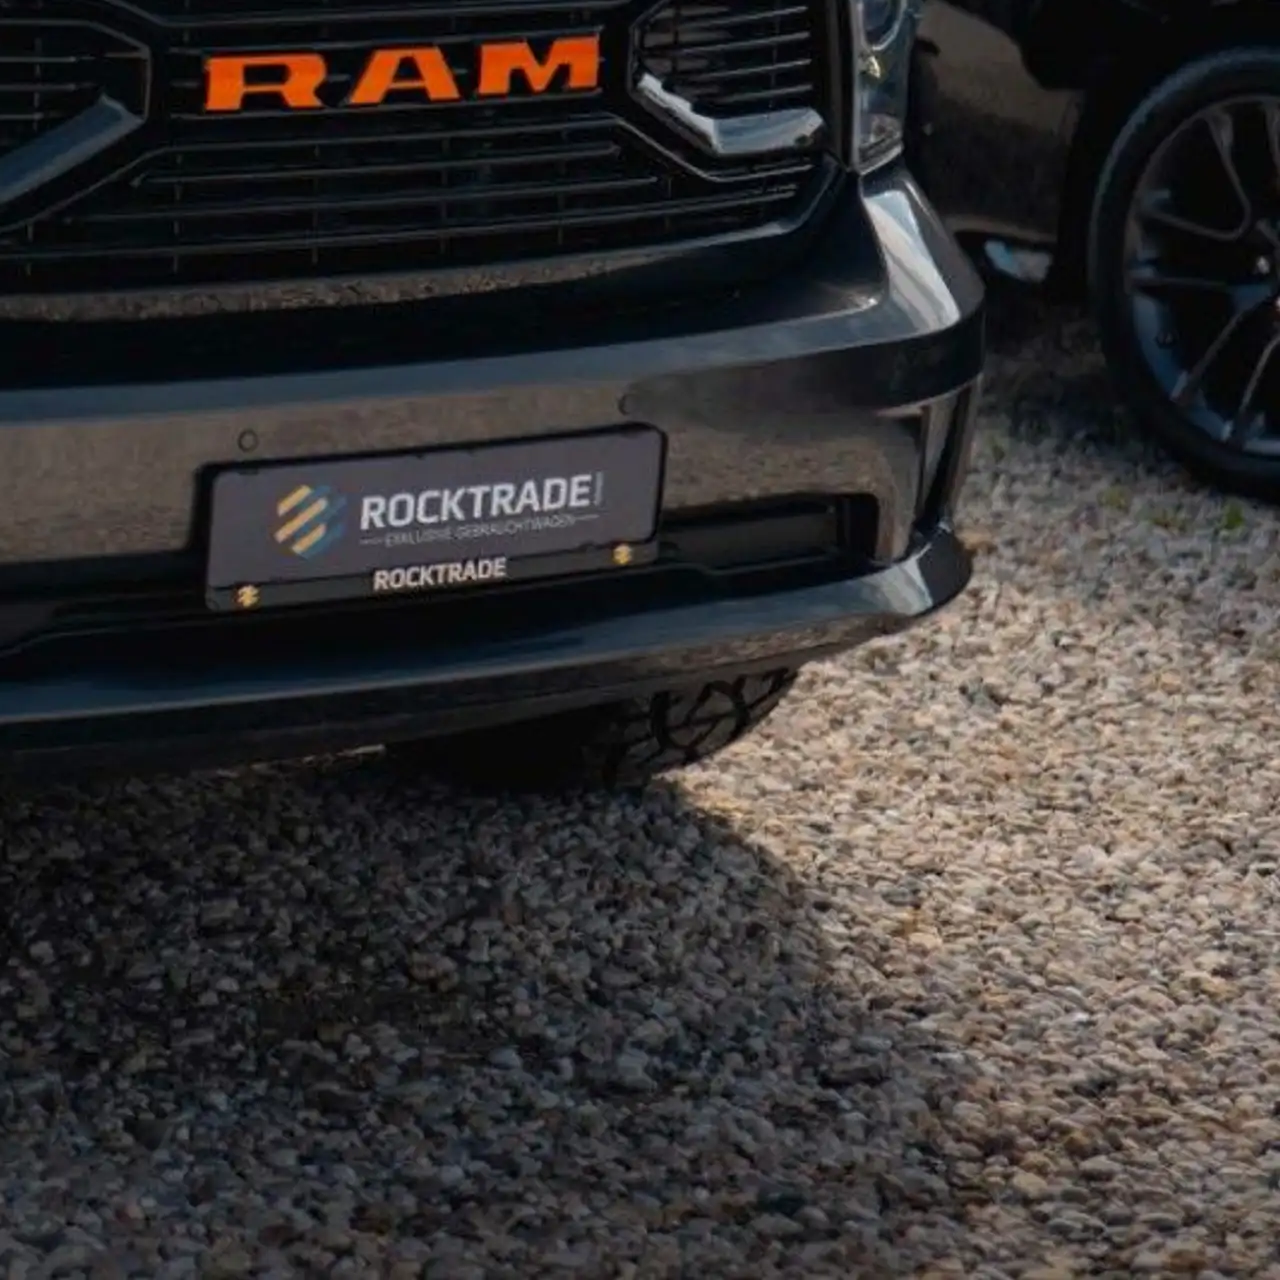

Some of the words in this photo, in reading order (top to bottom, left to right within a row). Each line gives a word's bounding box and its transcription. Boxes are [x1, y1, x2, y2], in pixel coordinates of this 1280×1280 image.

[204, 35, 600, 112] RAM
[359, 474, 593, 531] ROCKTRADE
[372, 556, 508, 591] ROCKTRADE
